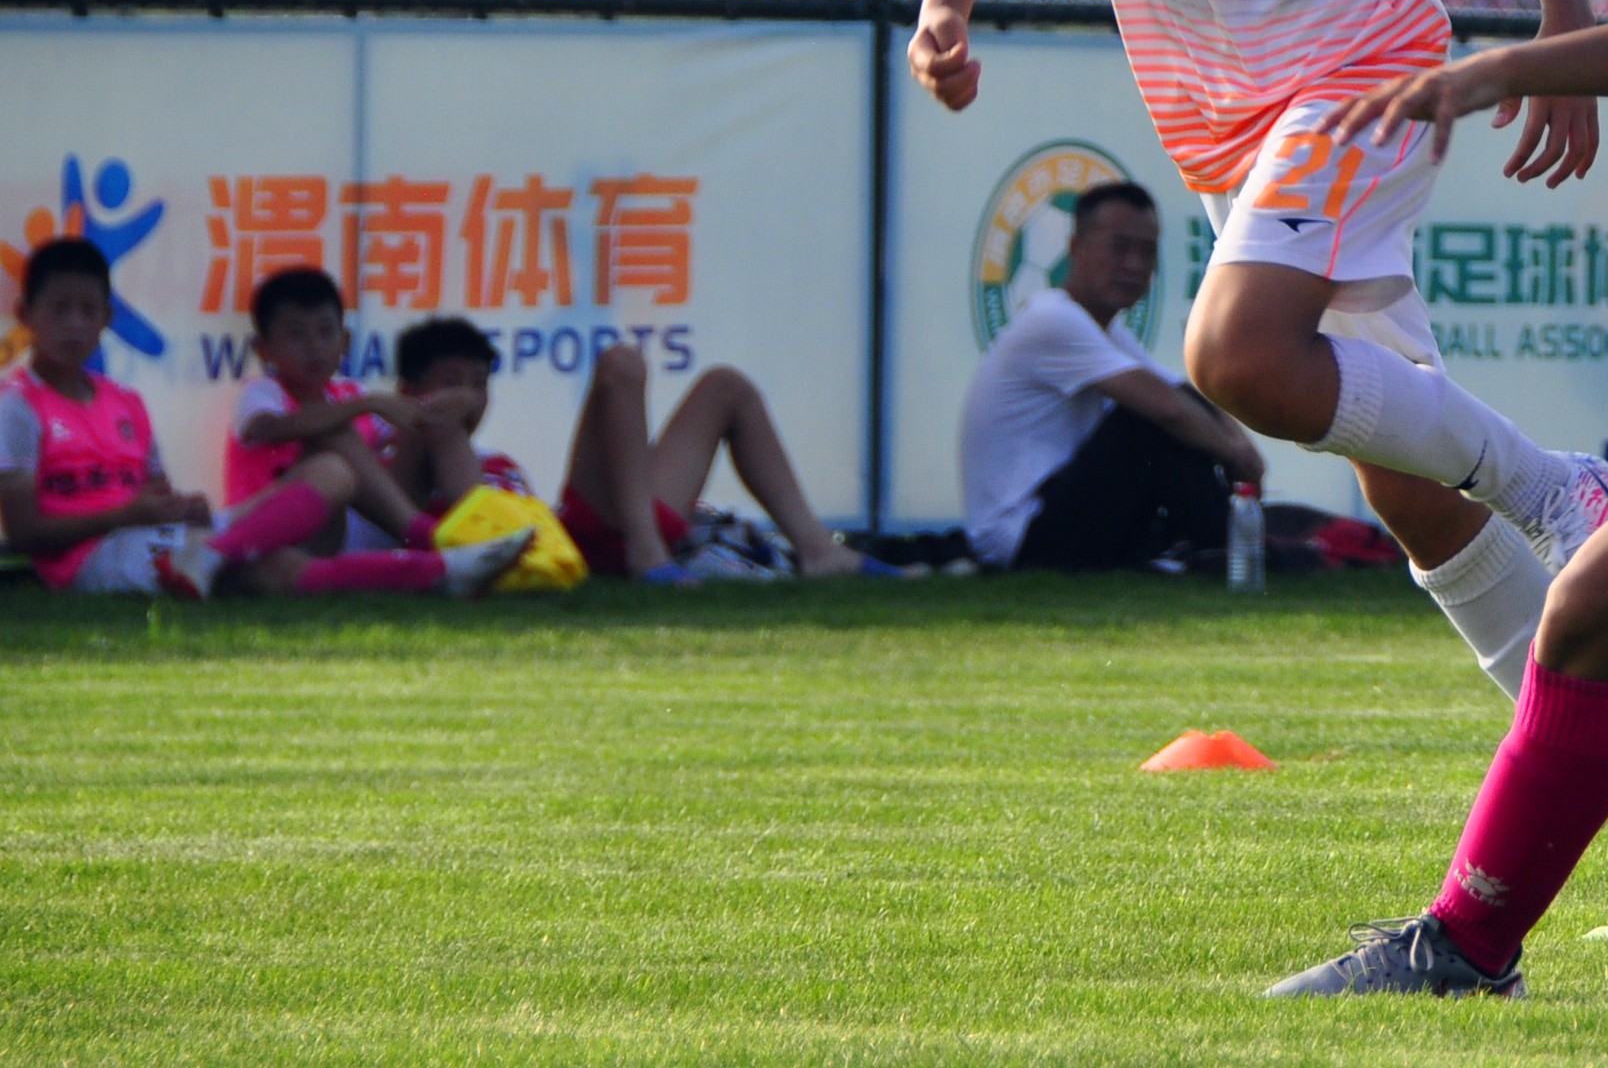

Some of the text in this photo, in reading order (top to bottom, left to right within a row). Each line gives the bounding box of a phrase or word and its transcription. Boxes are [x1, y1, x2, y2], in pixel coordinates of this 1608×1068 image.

[1253, 131, 1365, 220] 21
[200, 173, 699, 313] 渭南体育
